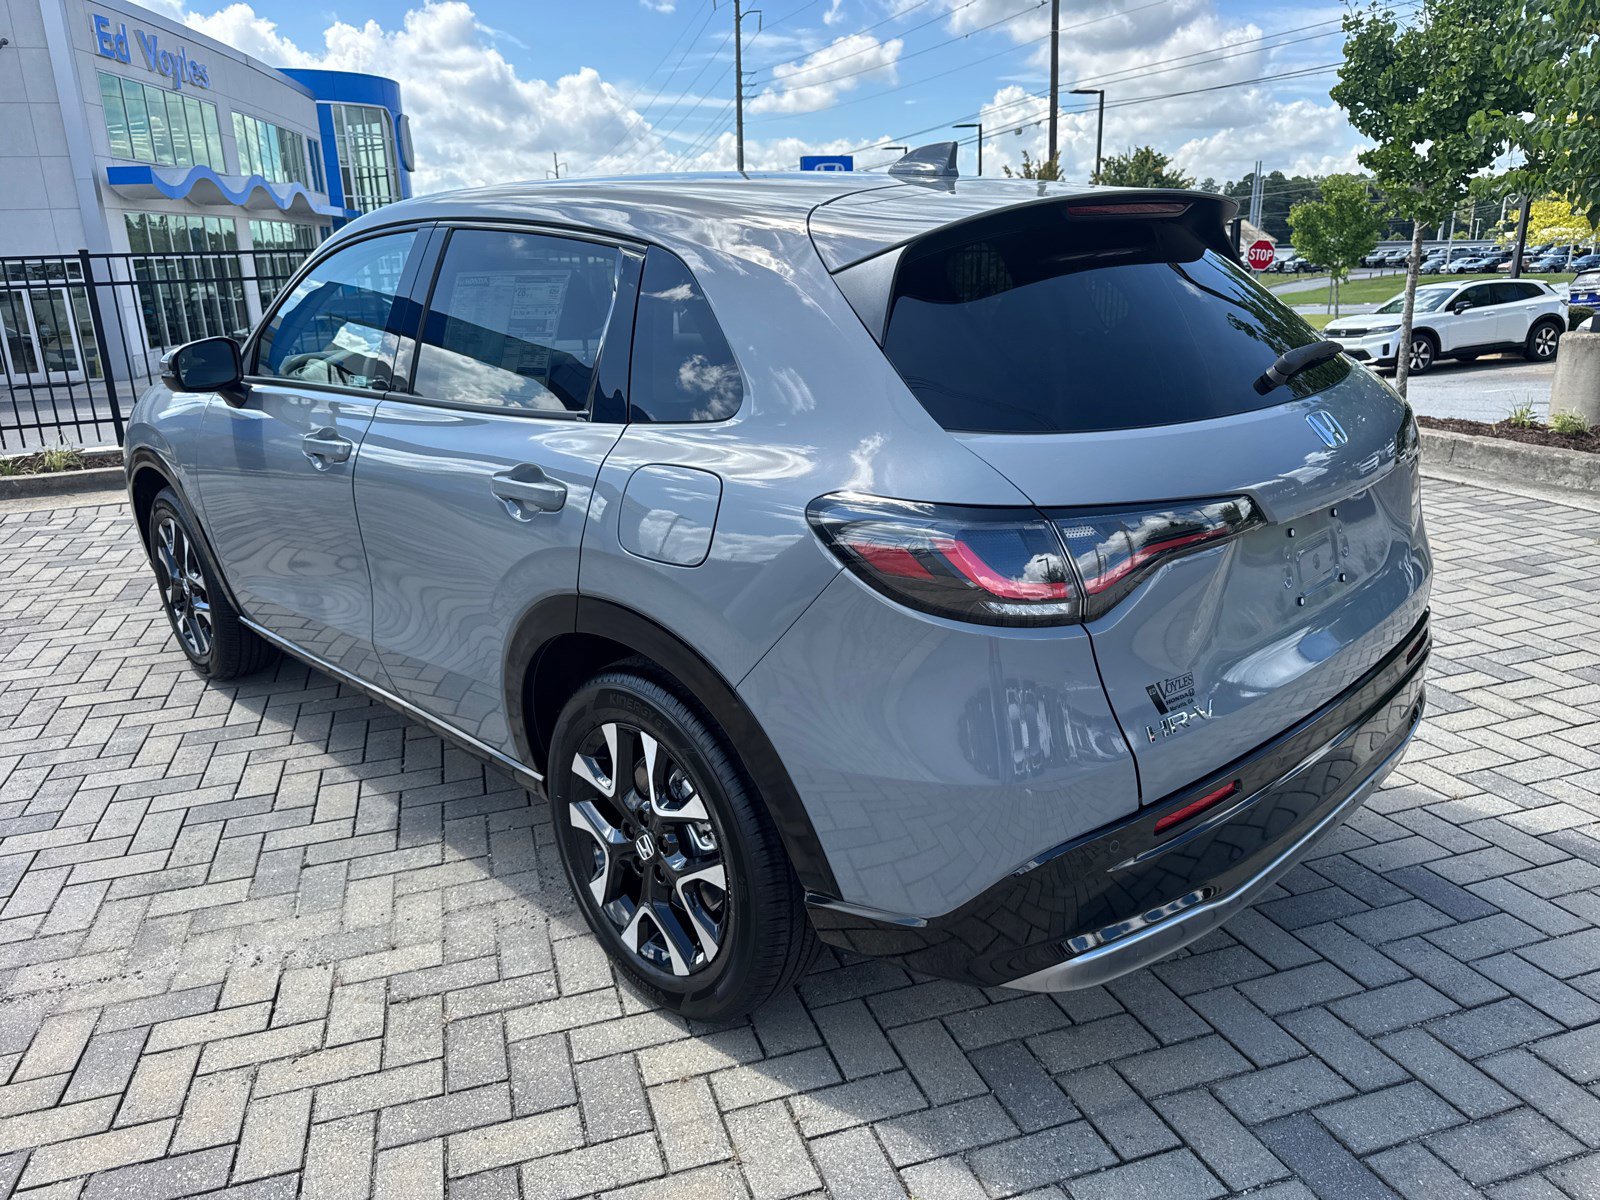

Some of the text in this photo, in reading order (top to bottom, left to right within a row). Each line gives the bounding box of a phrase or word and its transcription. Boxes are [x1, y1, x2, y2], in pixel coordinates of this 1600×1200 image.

[92, 13, 210, 90] Ed Voyles
[1248, 248, 1273, 262] STOP
[1166, 693, 1189, 705] HONDA
[1146, 699, 1213, 743] HR-V
